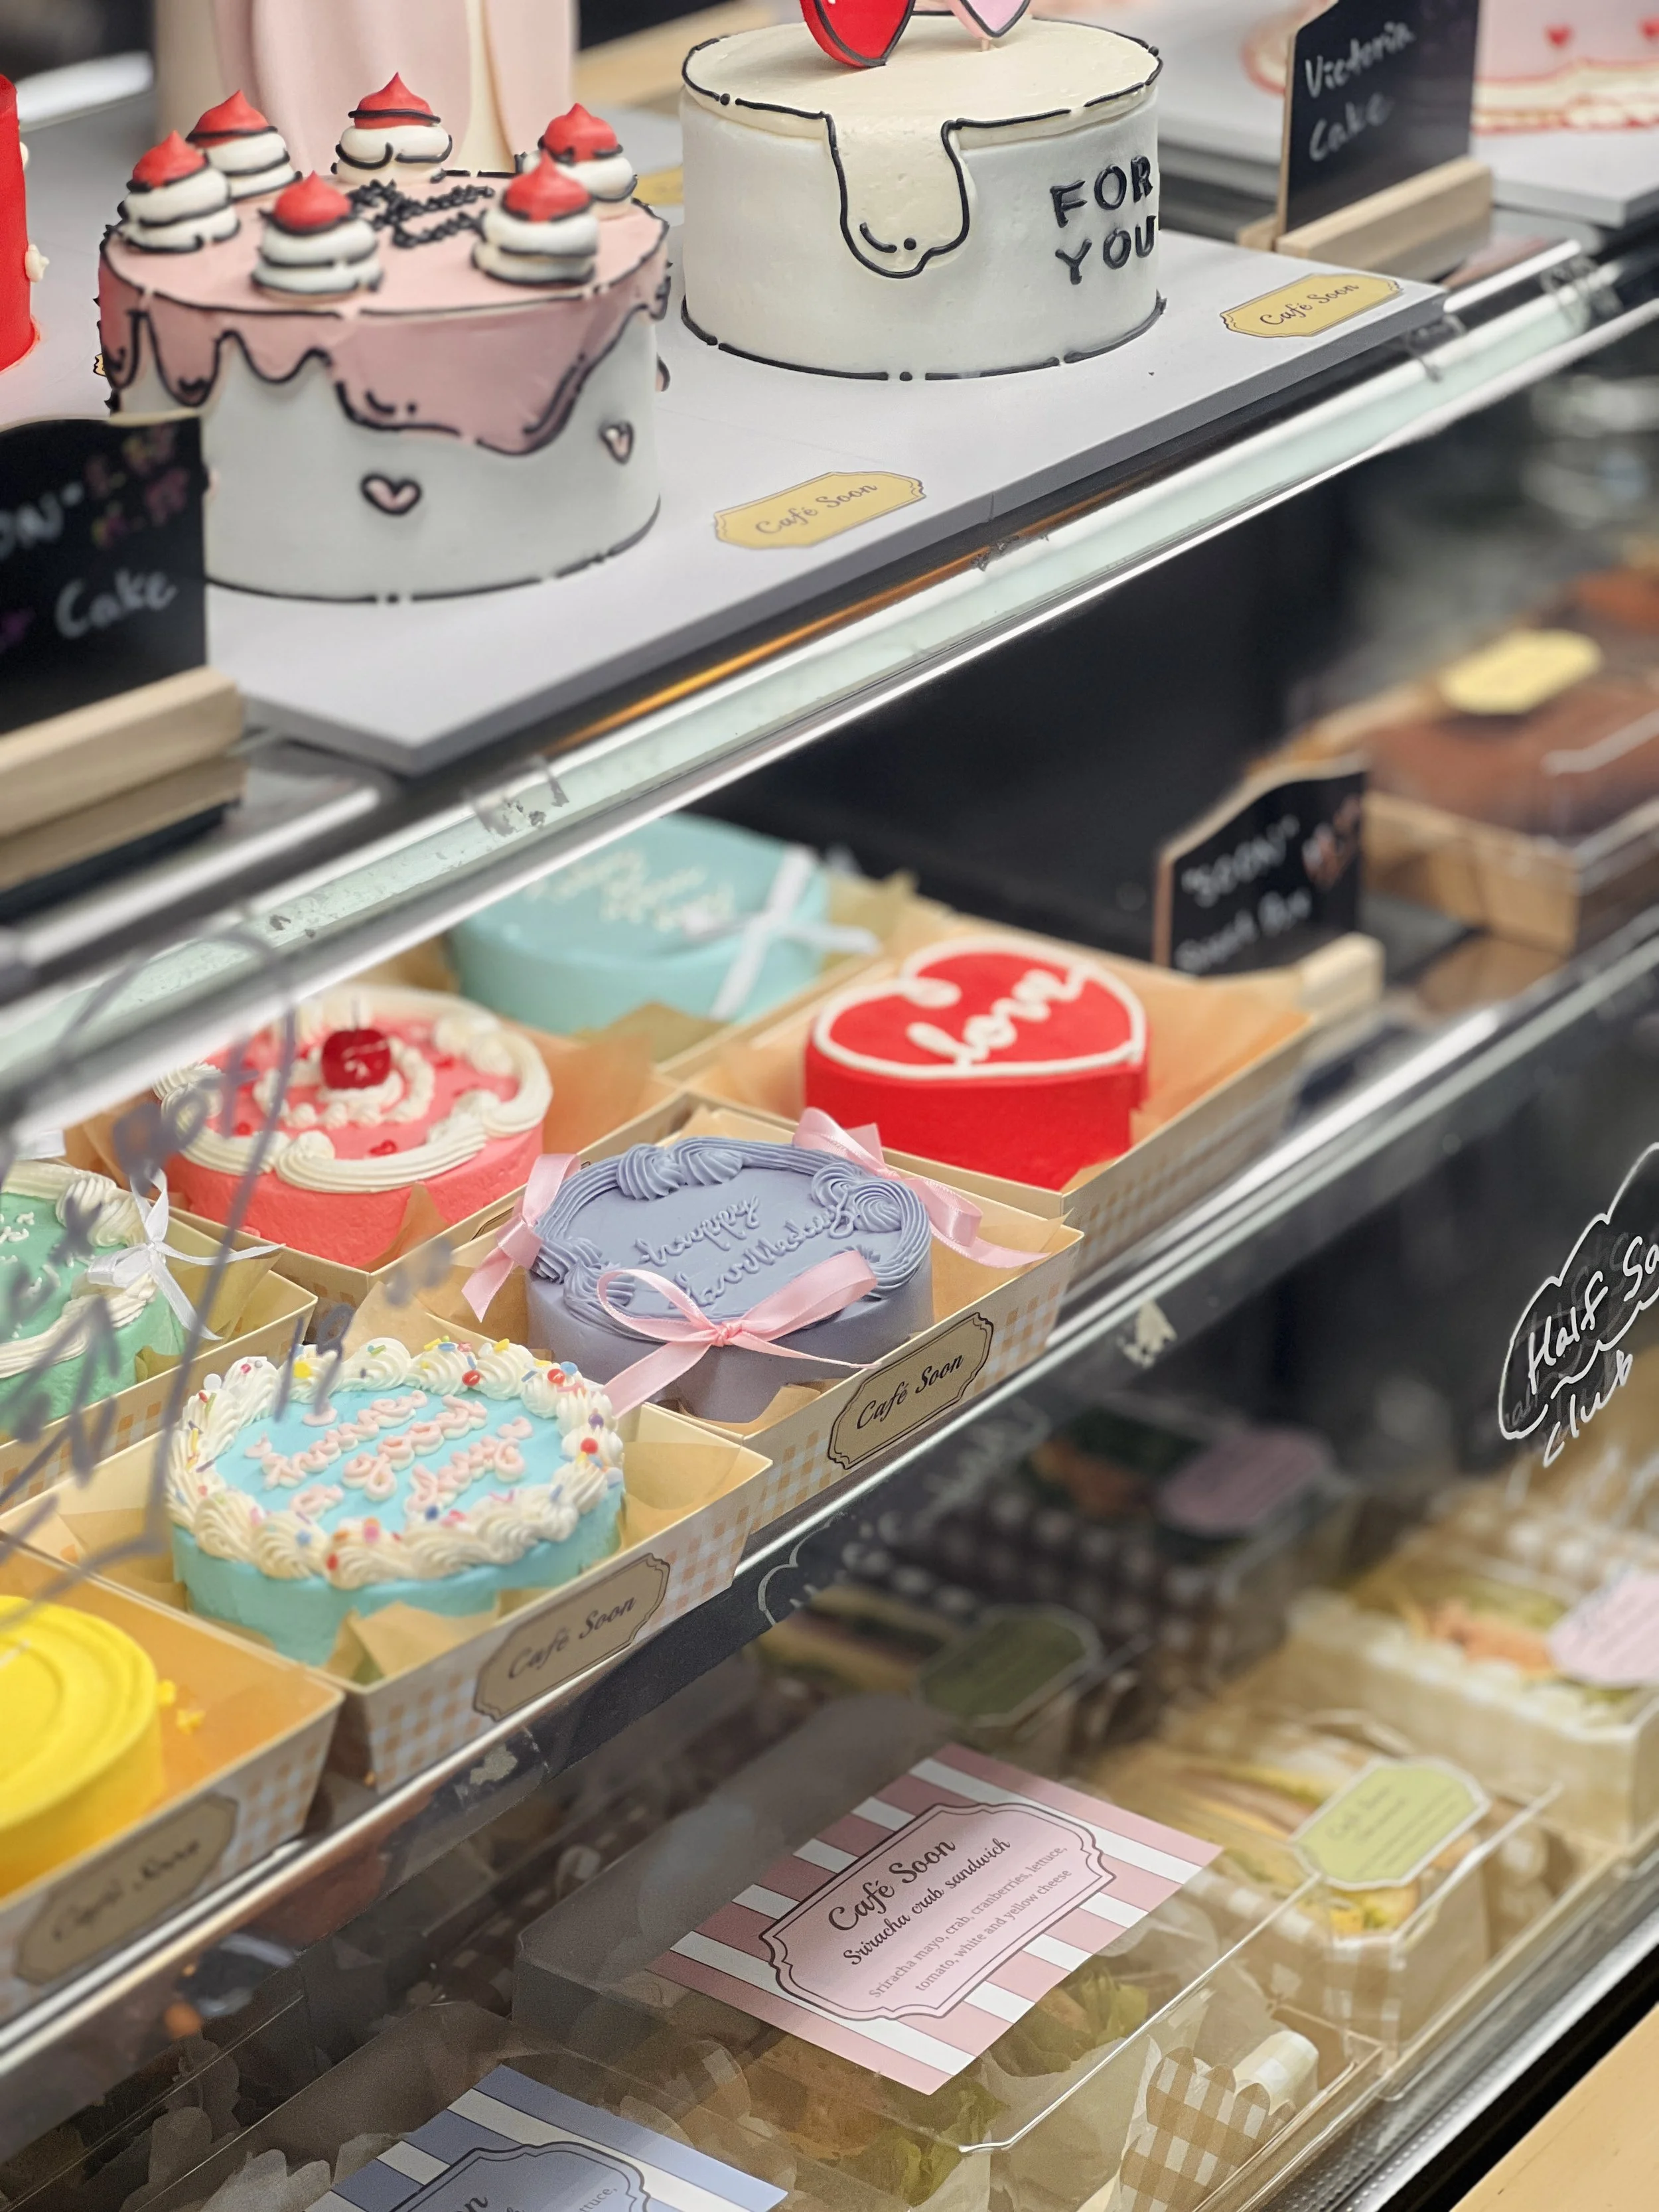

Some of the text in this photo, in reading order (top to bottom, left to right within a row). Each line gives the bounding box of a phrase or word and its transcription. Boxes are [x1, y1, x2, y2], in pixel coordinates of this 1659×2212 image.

[1305, 21, 1416, 98] Victoria
[1050, 155, 1153, 228] FOR
[1055, 215, 1156, 285] YOU
[1260, 284, 1359, 325] Café Soon
[755, 483, 878, 534] Café Soon
[55, 567, 178, 638] Cake
[1528, 1270, 1609, 1395] Half
[856, 1355, 964, 1429] Café Soon
[508, 1597, 636, 1679] Café Soon
[828, 1841, 956, 1931] Café Soon
[843, 1838, 1011, 1965] Sriracha crab sandwich
[869, 1846, 1068, 1998] Sriracha mayo, crab, cranberries, lettuce,
[915, 1869, 1072, 1992] tomato, white and yellow cheese
